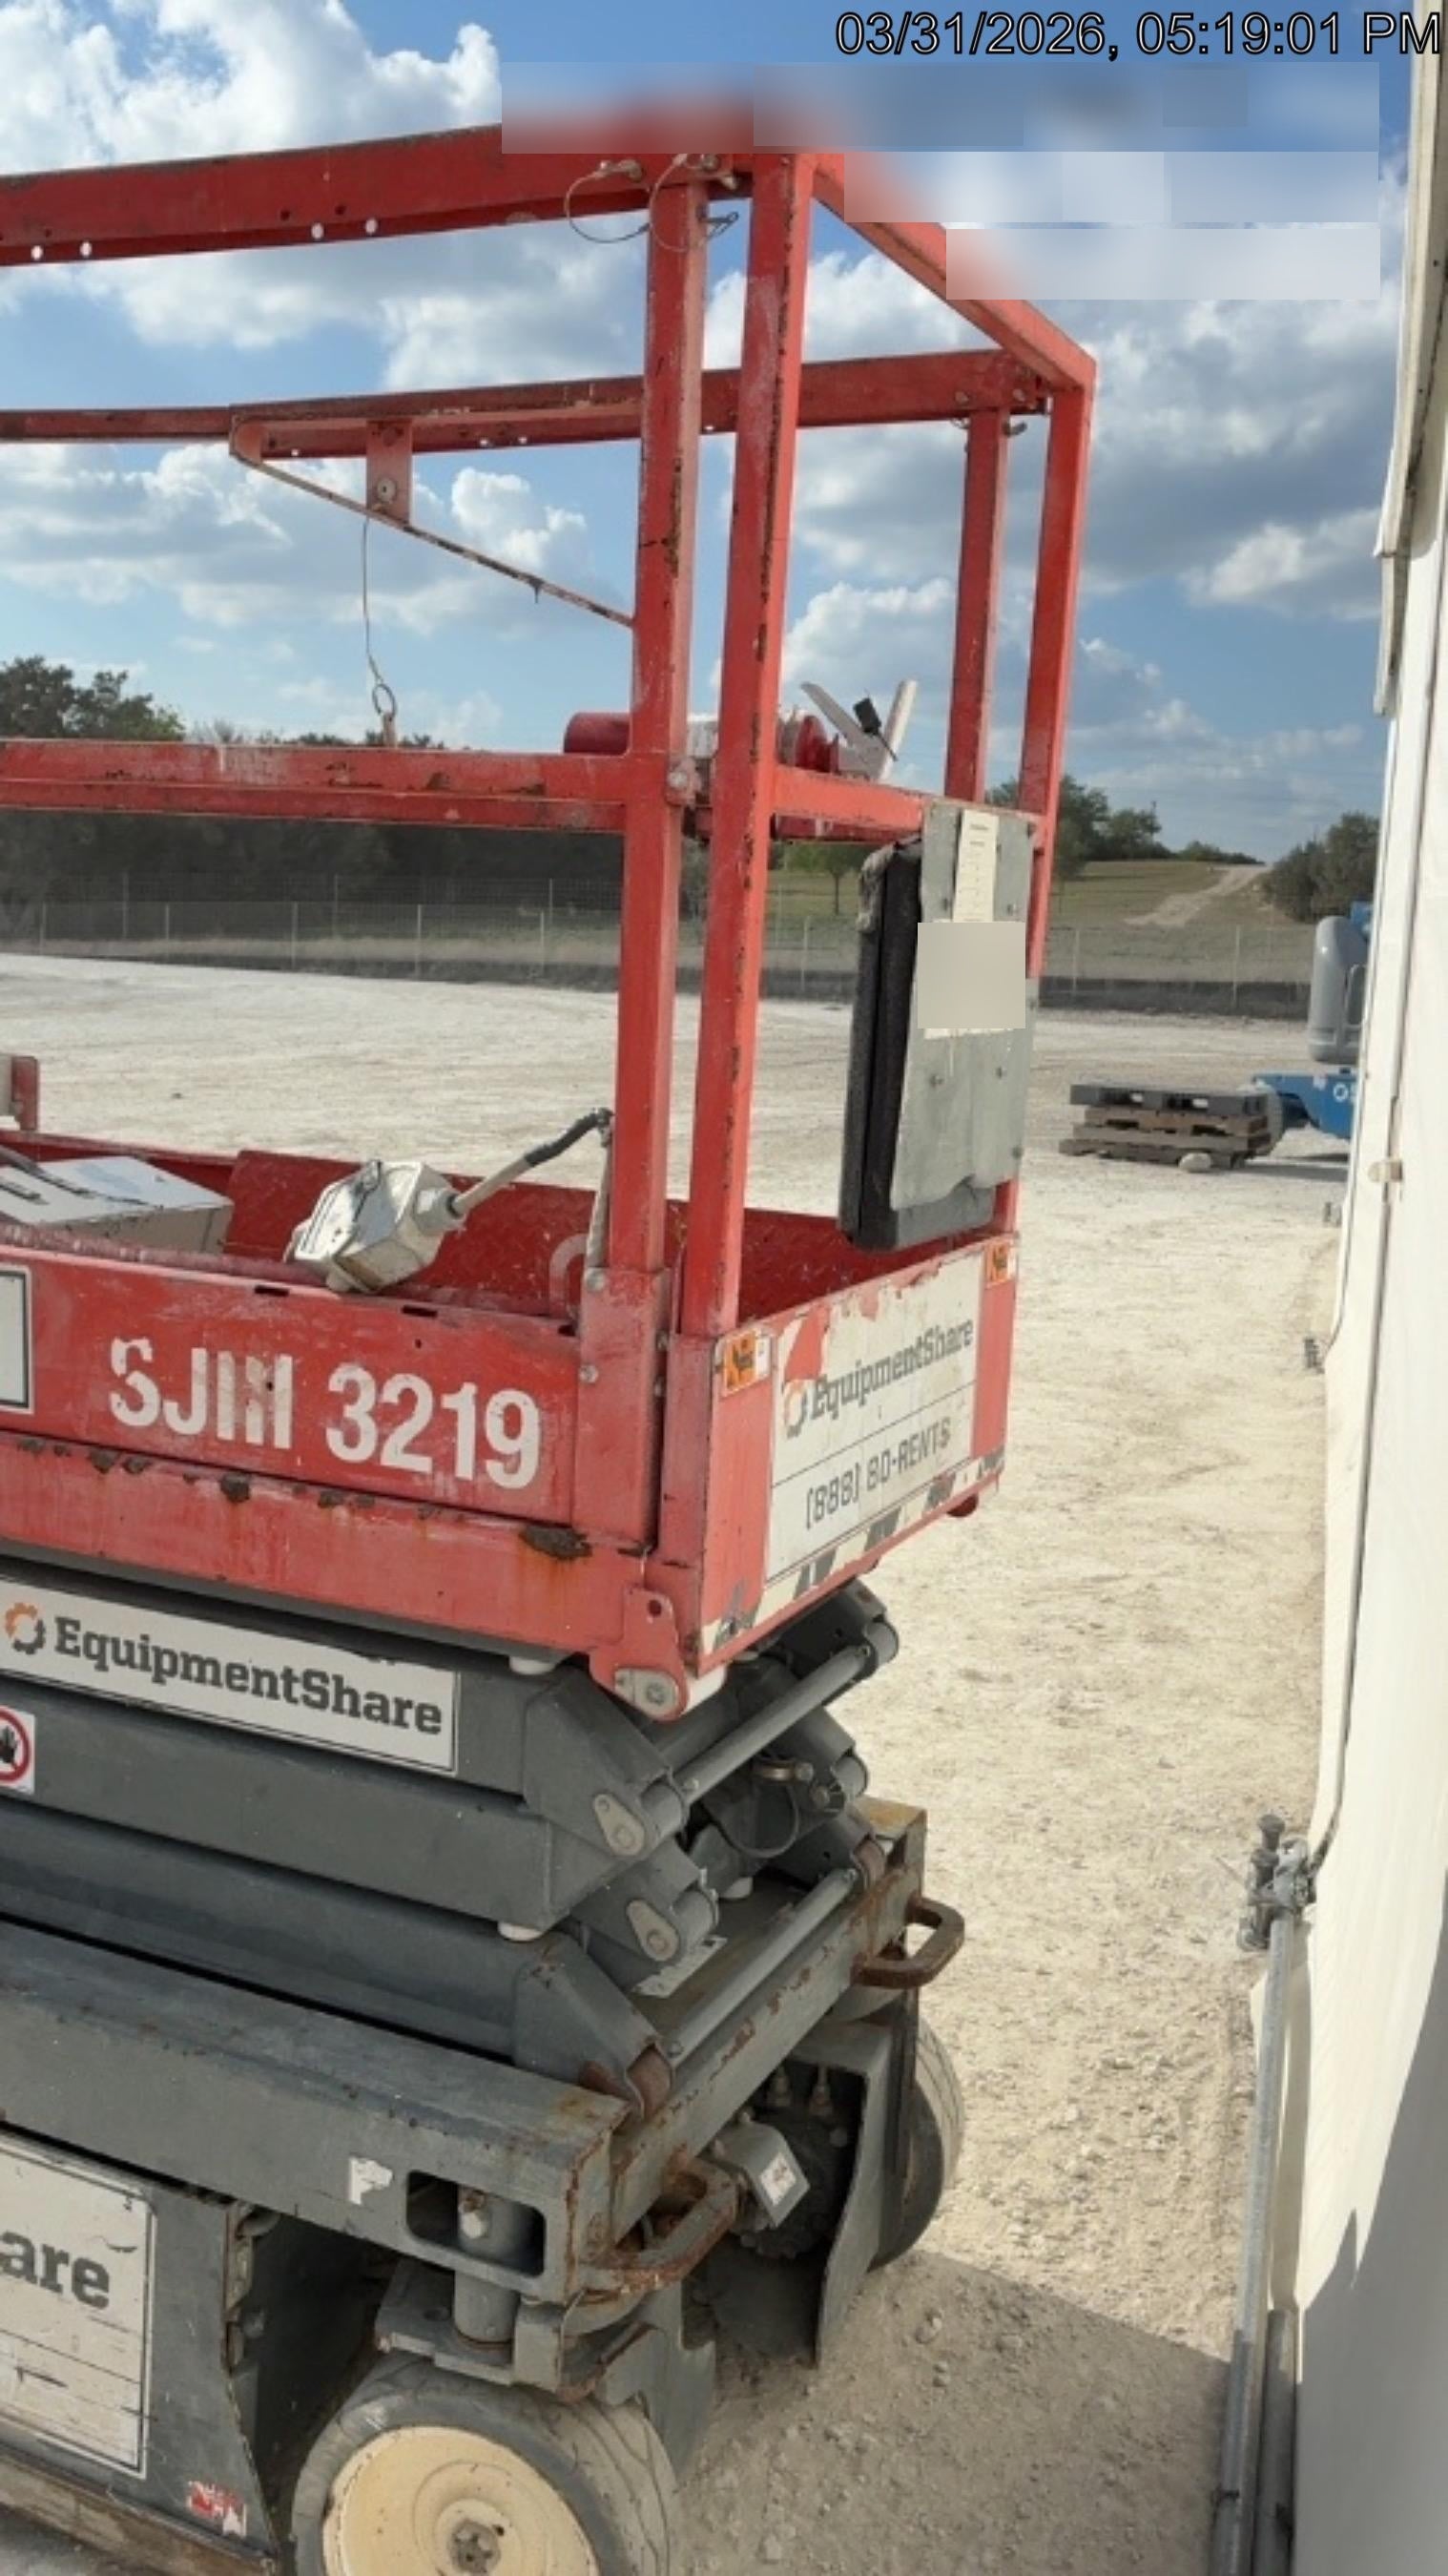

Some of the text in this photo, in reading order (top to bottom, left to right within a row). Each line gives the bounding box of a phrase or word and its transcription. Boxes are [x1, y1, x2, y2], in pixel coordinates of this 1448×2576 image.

[326, 1361, 541, 1489] 3219
[811, 1319, 974, 1422] EquipmentShare
[806, 1417, 952, 1530] (888) 80-RENTS
[53, 1615, 444, 1736] EquipmentShare
